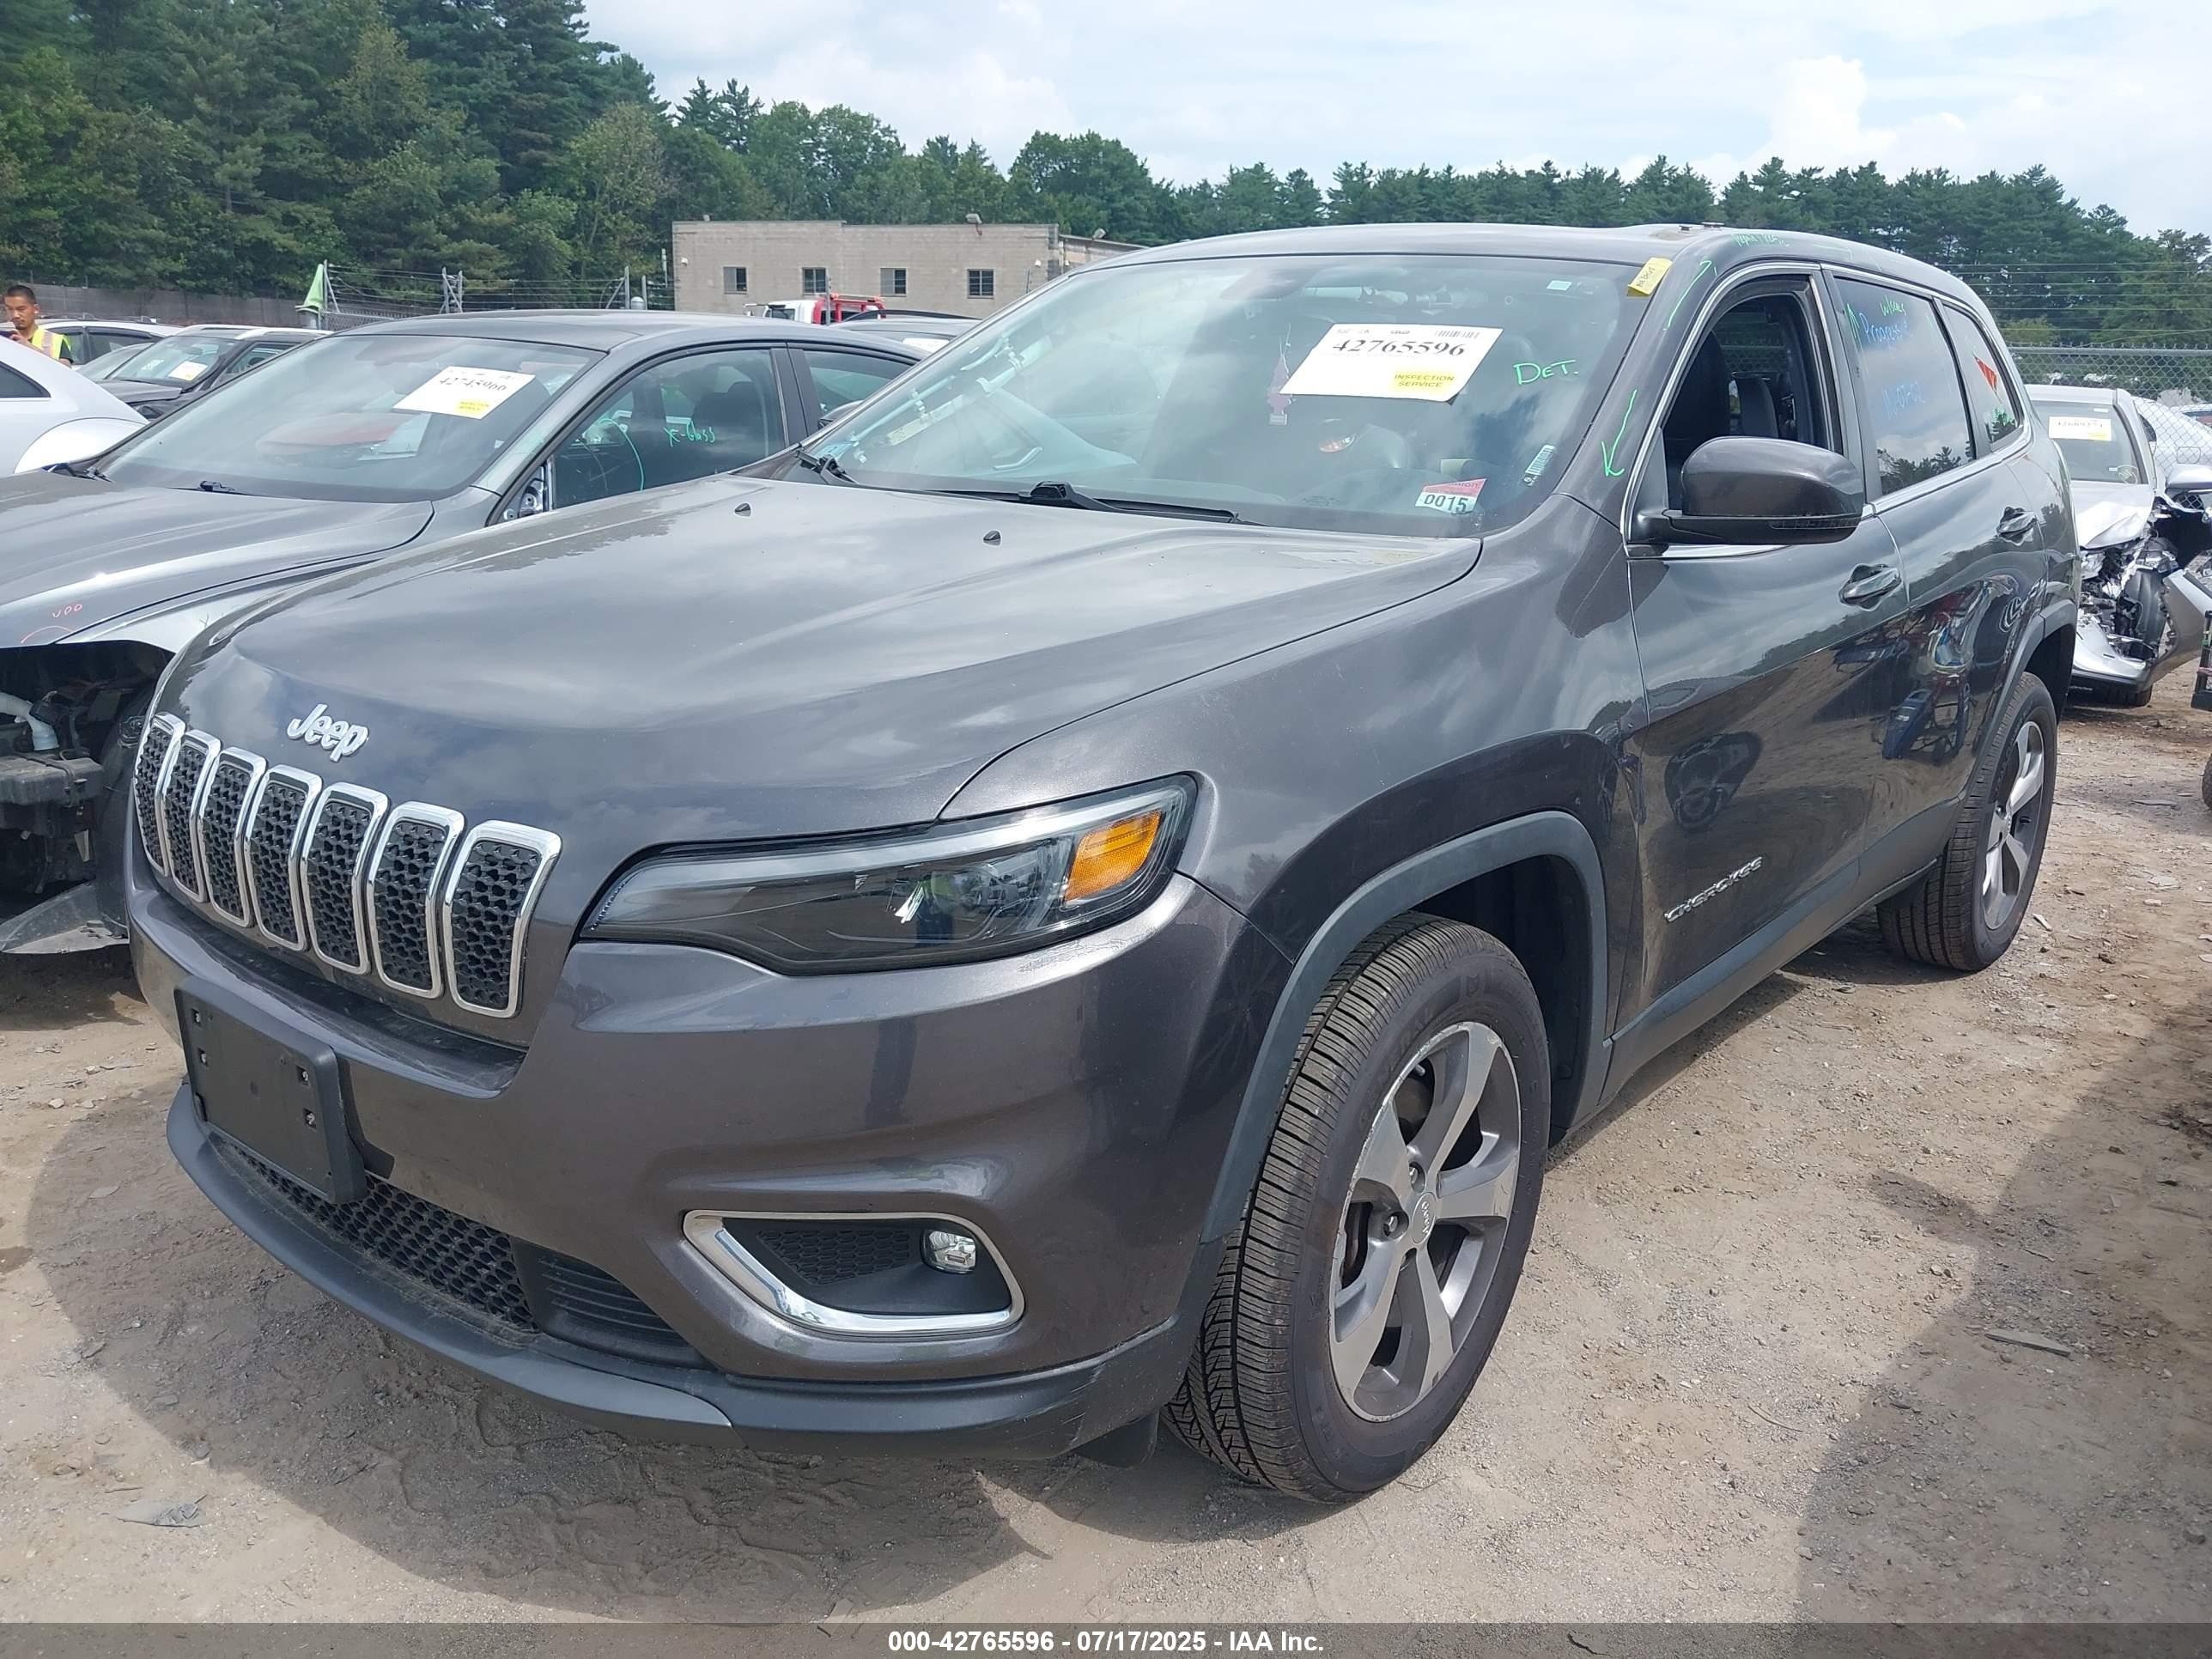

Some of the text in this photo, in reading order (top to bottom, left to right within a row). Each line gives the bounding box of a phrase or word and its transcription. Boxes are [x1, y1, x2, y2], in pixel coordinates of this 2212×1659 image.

[1333, 339, 1466, 356] 42765596
[1424, 494, 1468, 513] 0015
[287, 703, 369, 763] Jeep
